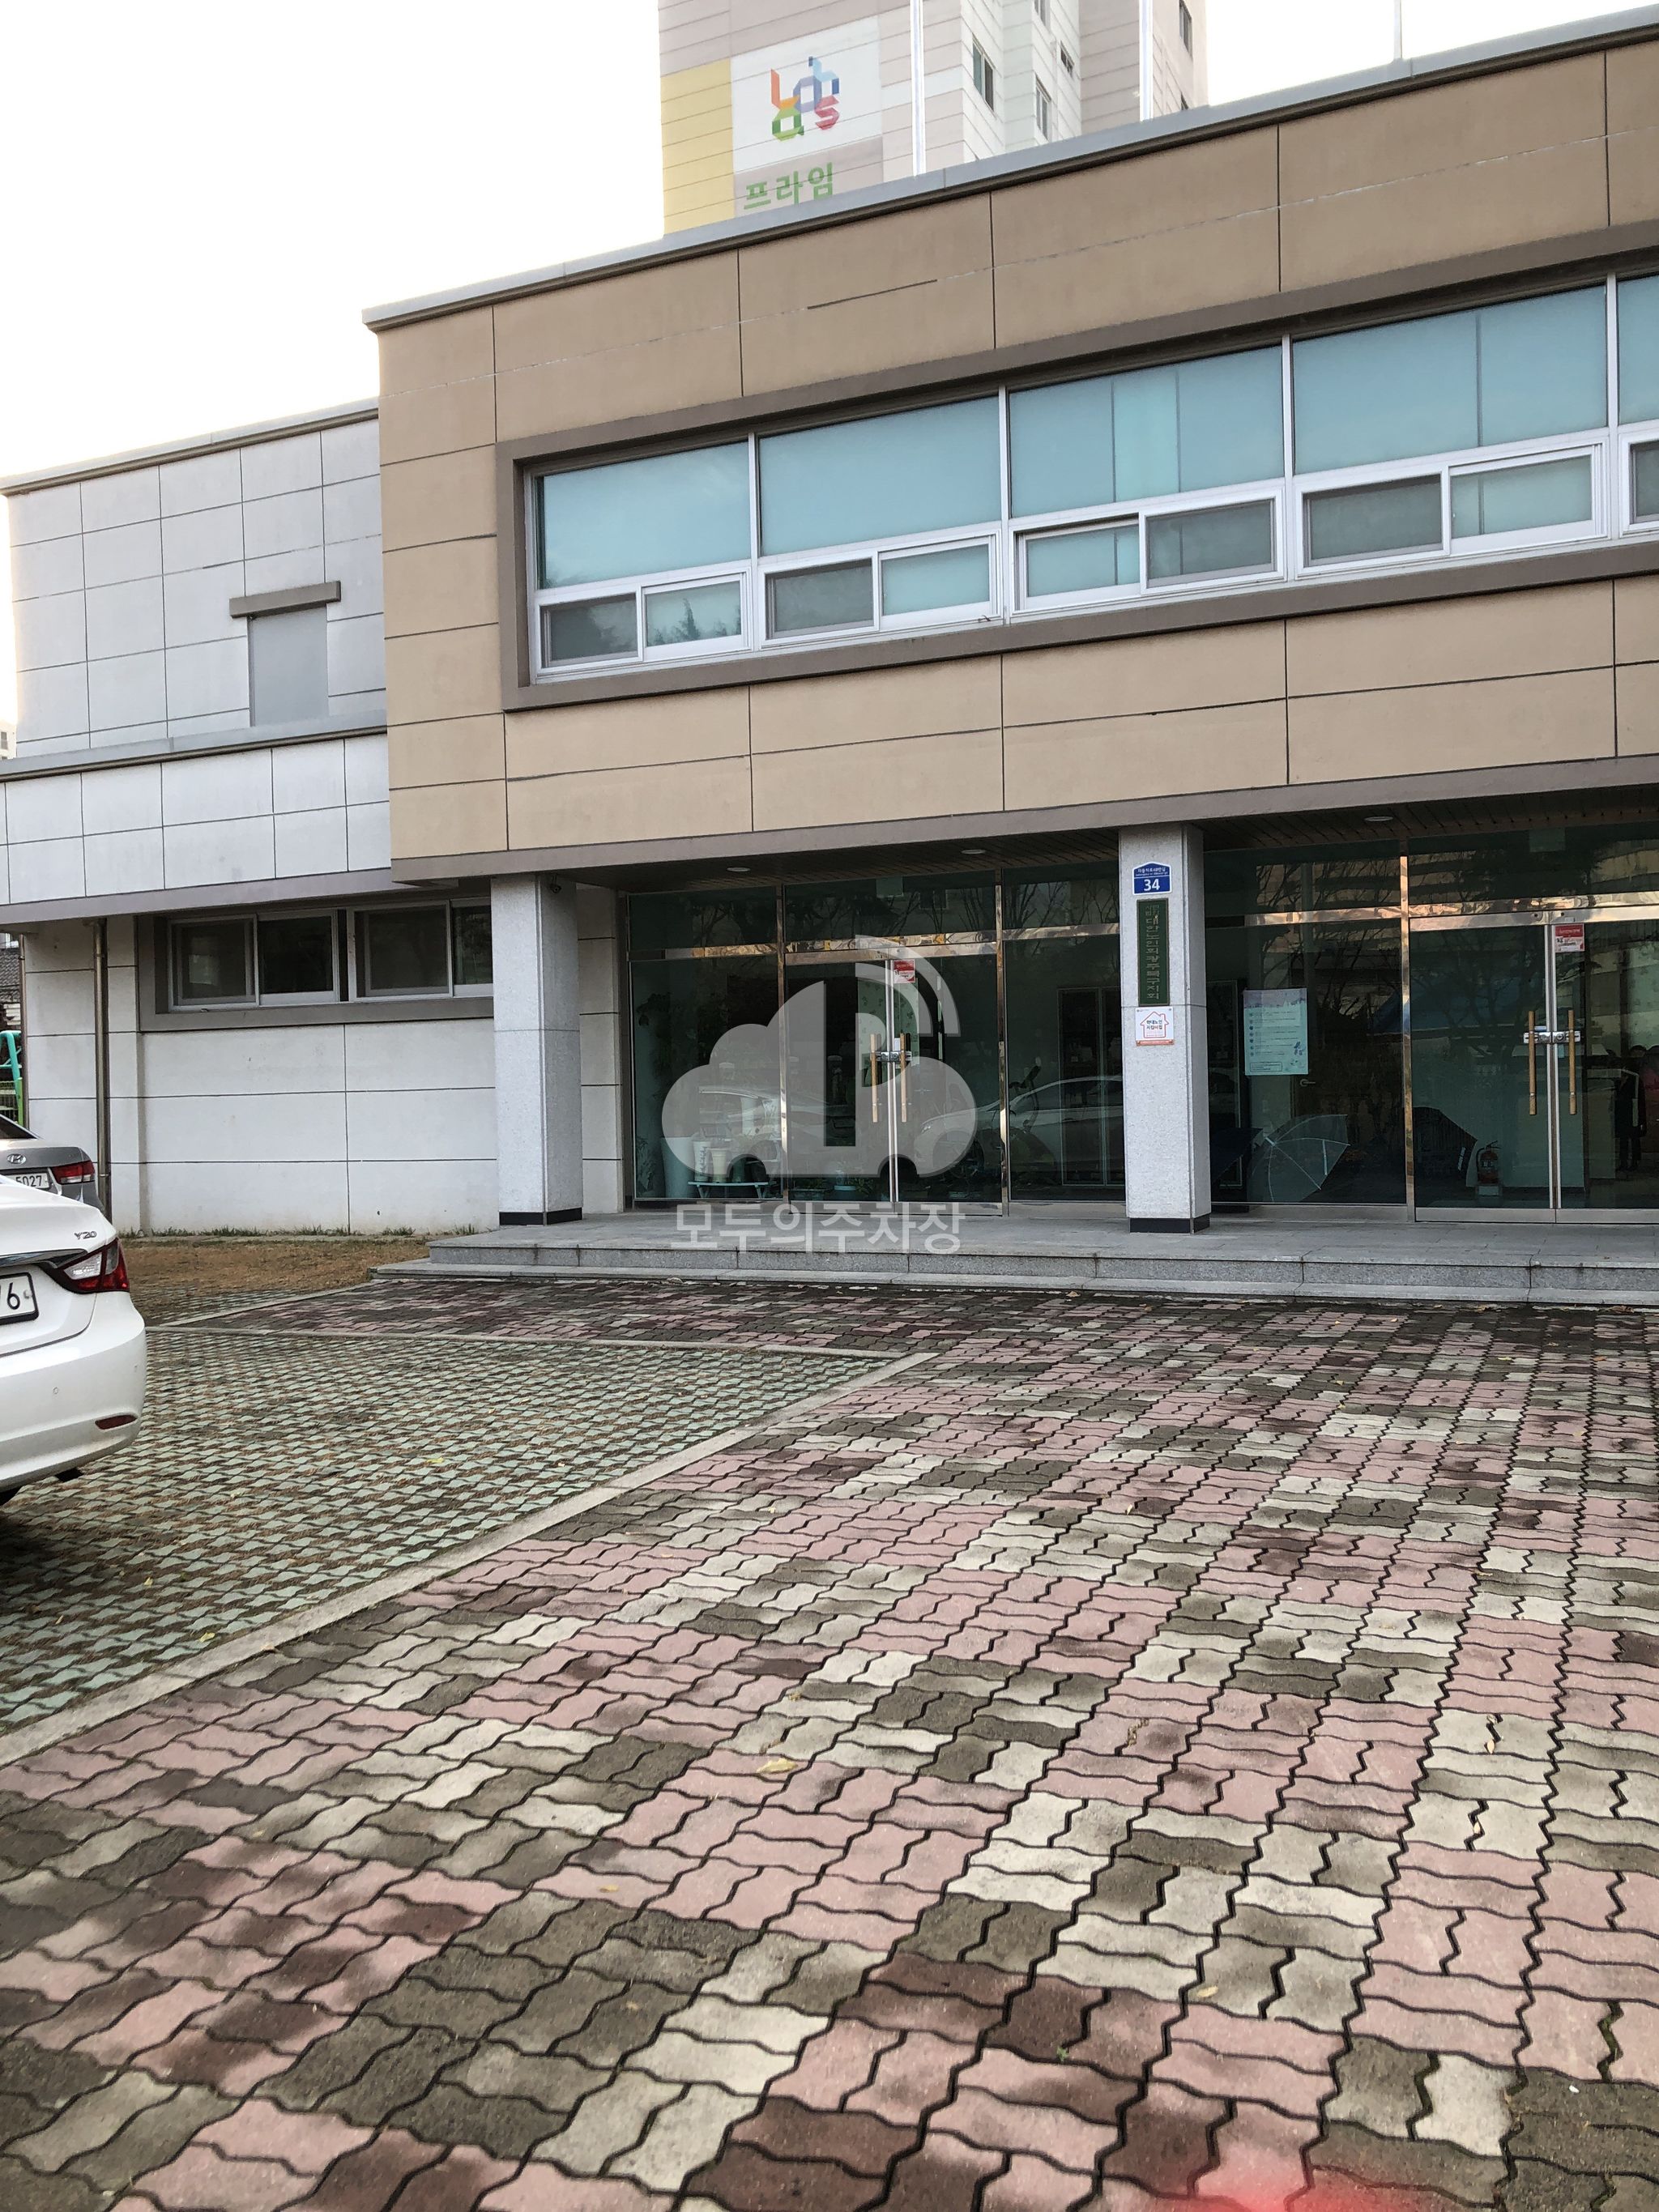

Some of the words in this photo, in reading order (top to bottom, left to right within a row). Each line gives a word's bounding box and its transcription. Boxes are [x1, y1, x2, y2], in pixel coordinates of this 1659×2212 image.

[744, 163, 833, 210] 프라임
[1144, 879, 1160, 891] 34
[74, 1231, 96, 1240] Y20
[0, 1282, 20, 1310] 6
